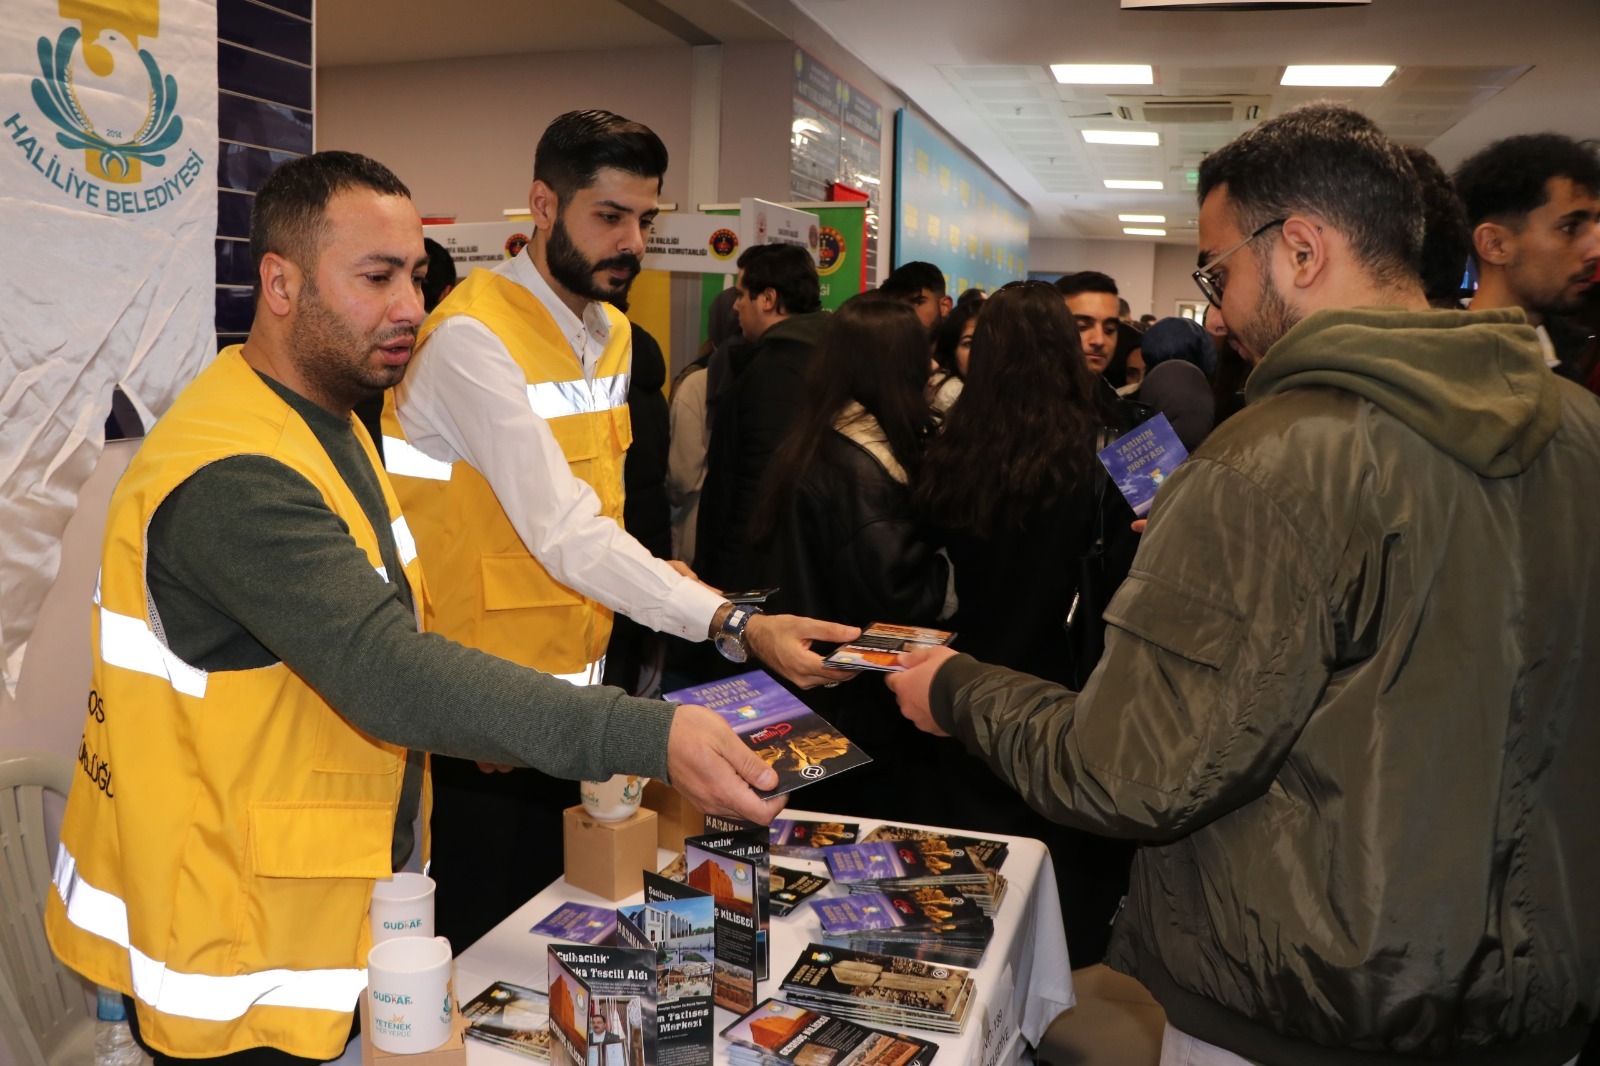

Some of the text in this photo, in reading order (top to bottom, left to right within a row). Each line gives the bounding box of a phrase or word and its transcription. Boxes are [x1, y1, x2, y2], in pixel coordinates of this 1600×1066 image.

[106, 128, 122, 139] 2014
[4, 113, 205, 214] HALİLİYE BELEDİYESİ
[721, 909, 753, 928] KİLİSESİ
[590, 968, 625, 979] Tescili
[627, 969, 649, 980] Aldı
[375, 1016, 411, 1030] YETENEK
[660, 1019, 702, 1033] Merkezi
